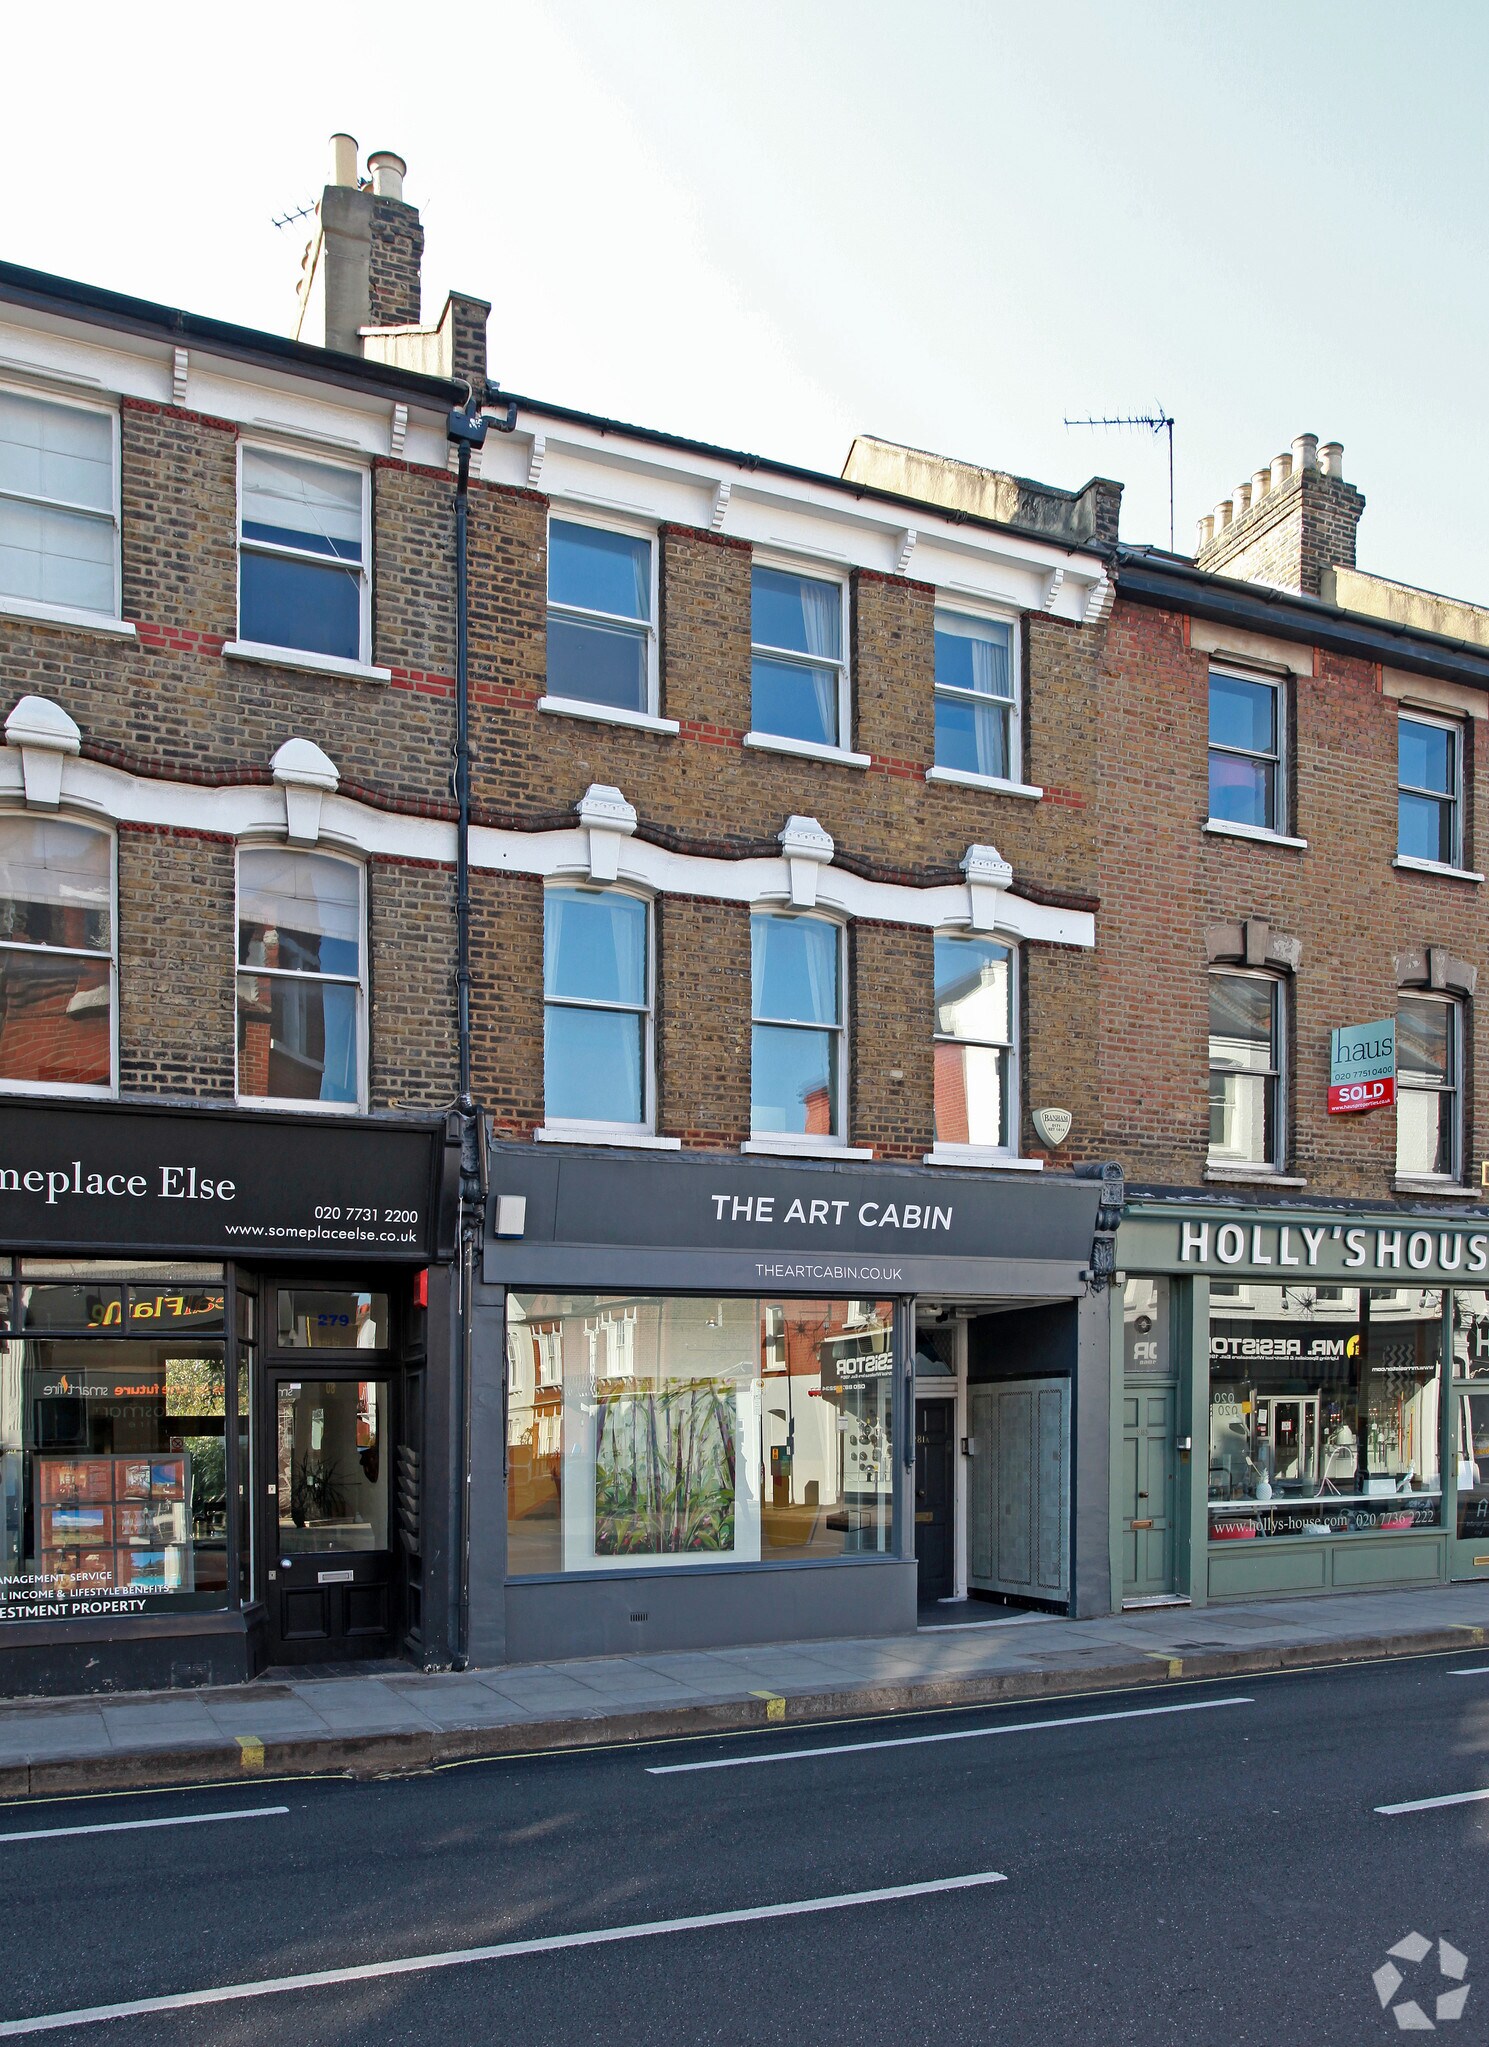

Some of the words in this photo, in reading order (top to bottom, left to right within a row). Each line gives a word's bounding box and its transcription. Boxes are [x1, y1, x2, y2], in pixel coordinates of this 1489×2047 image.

[1334, 1028, 1392, 1064] haus
[1335, 1072, 1351, 1081] 020
[1338, 1083, 1385, 1103] SOLD
[157, 1166, 236, 1201] Else
[314, 1205, 341, 1220] 020
[345, 1206, 378, 1222] 7731
[384, 1208, 418, 1224] 2200
[711, 1194, 774, 1223] THE
[784, 1199, 850, 1226] ART
[858, 1201, 954, 1231] CABIN
[224, 1224, 418, 1244] www.someplaceelse.co.uk
[1180, 1220, 1367, 1268] HOLLY'S
[1376, 1230, 1488, 1273] HOUS
[755, 1262, 903, 1282] THEARTCABIN.CO.UK
[317, 1314, 350, 1327] 279
[1214, 1513, 1348, 1534] www.hollys-house.com
[1356, 1512, 1376, 1528] 020
[1380, 1511, 1406, 1527] 7736
[1408, 1509, 1434, 1525] 2222
[70, 1571, 112, 1582] SERVICE
[9, 1589, 54, 1600] INCOME
[56, 1589, 66, 1599] &
[70, 1587, 120, 1598] LIFESTYLE
[122, 1584, 170, 1595] BENEFITS
[72, 1599, 146, 1615] PROPERTY
